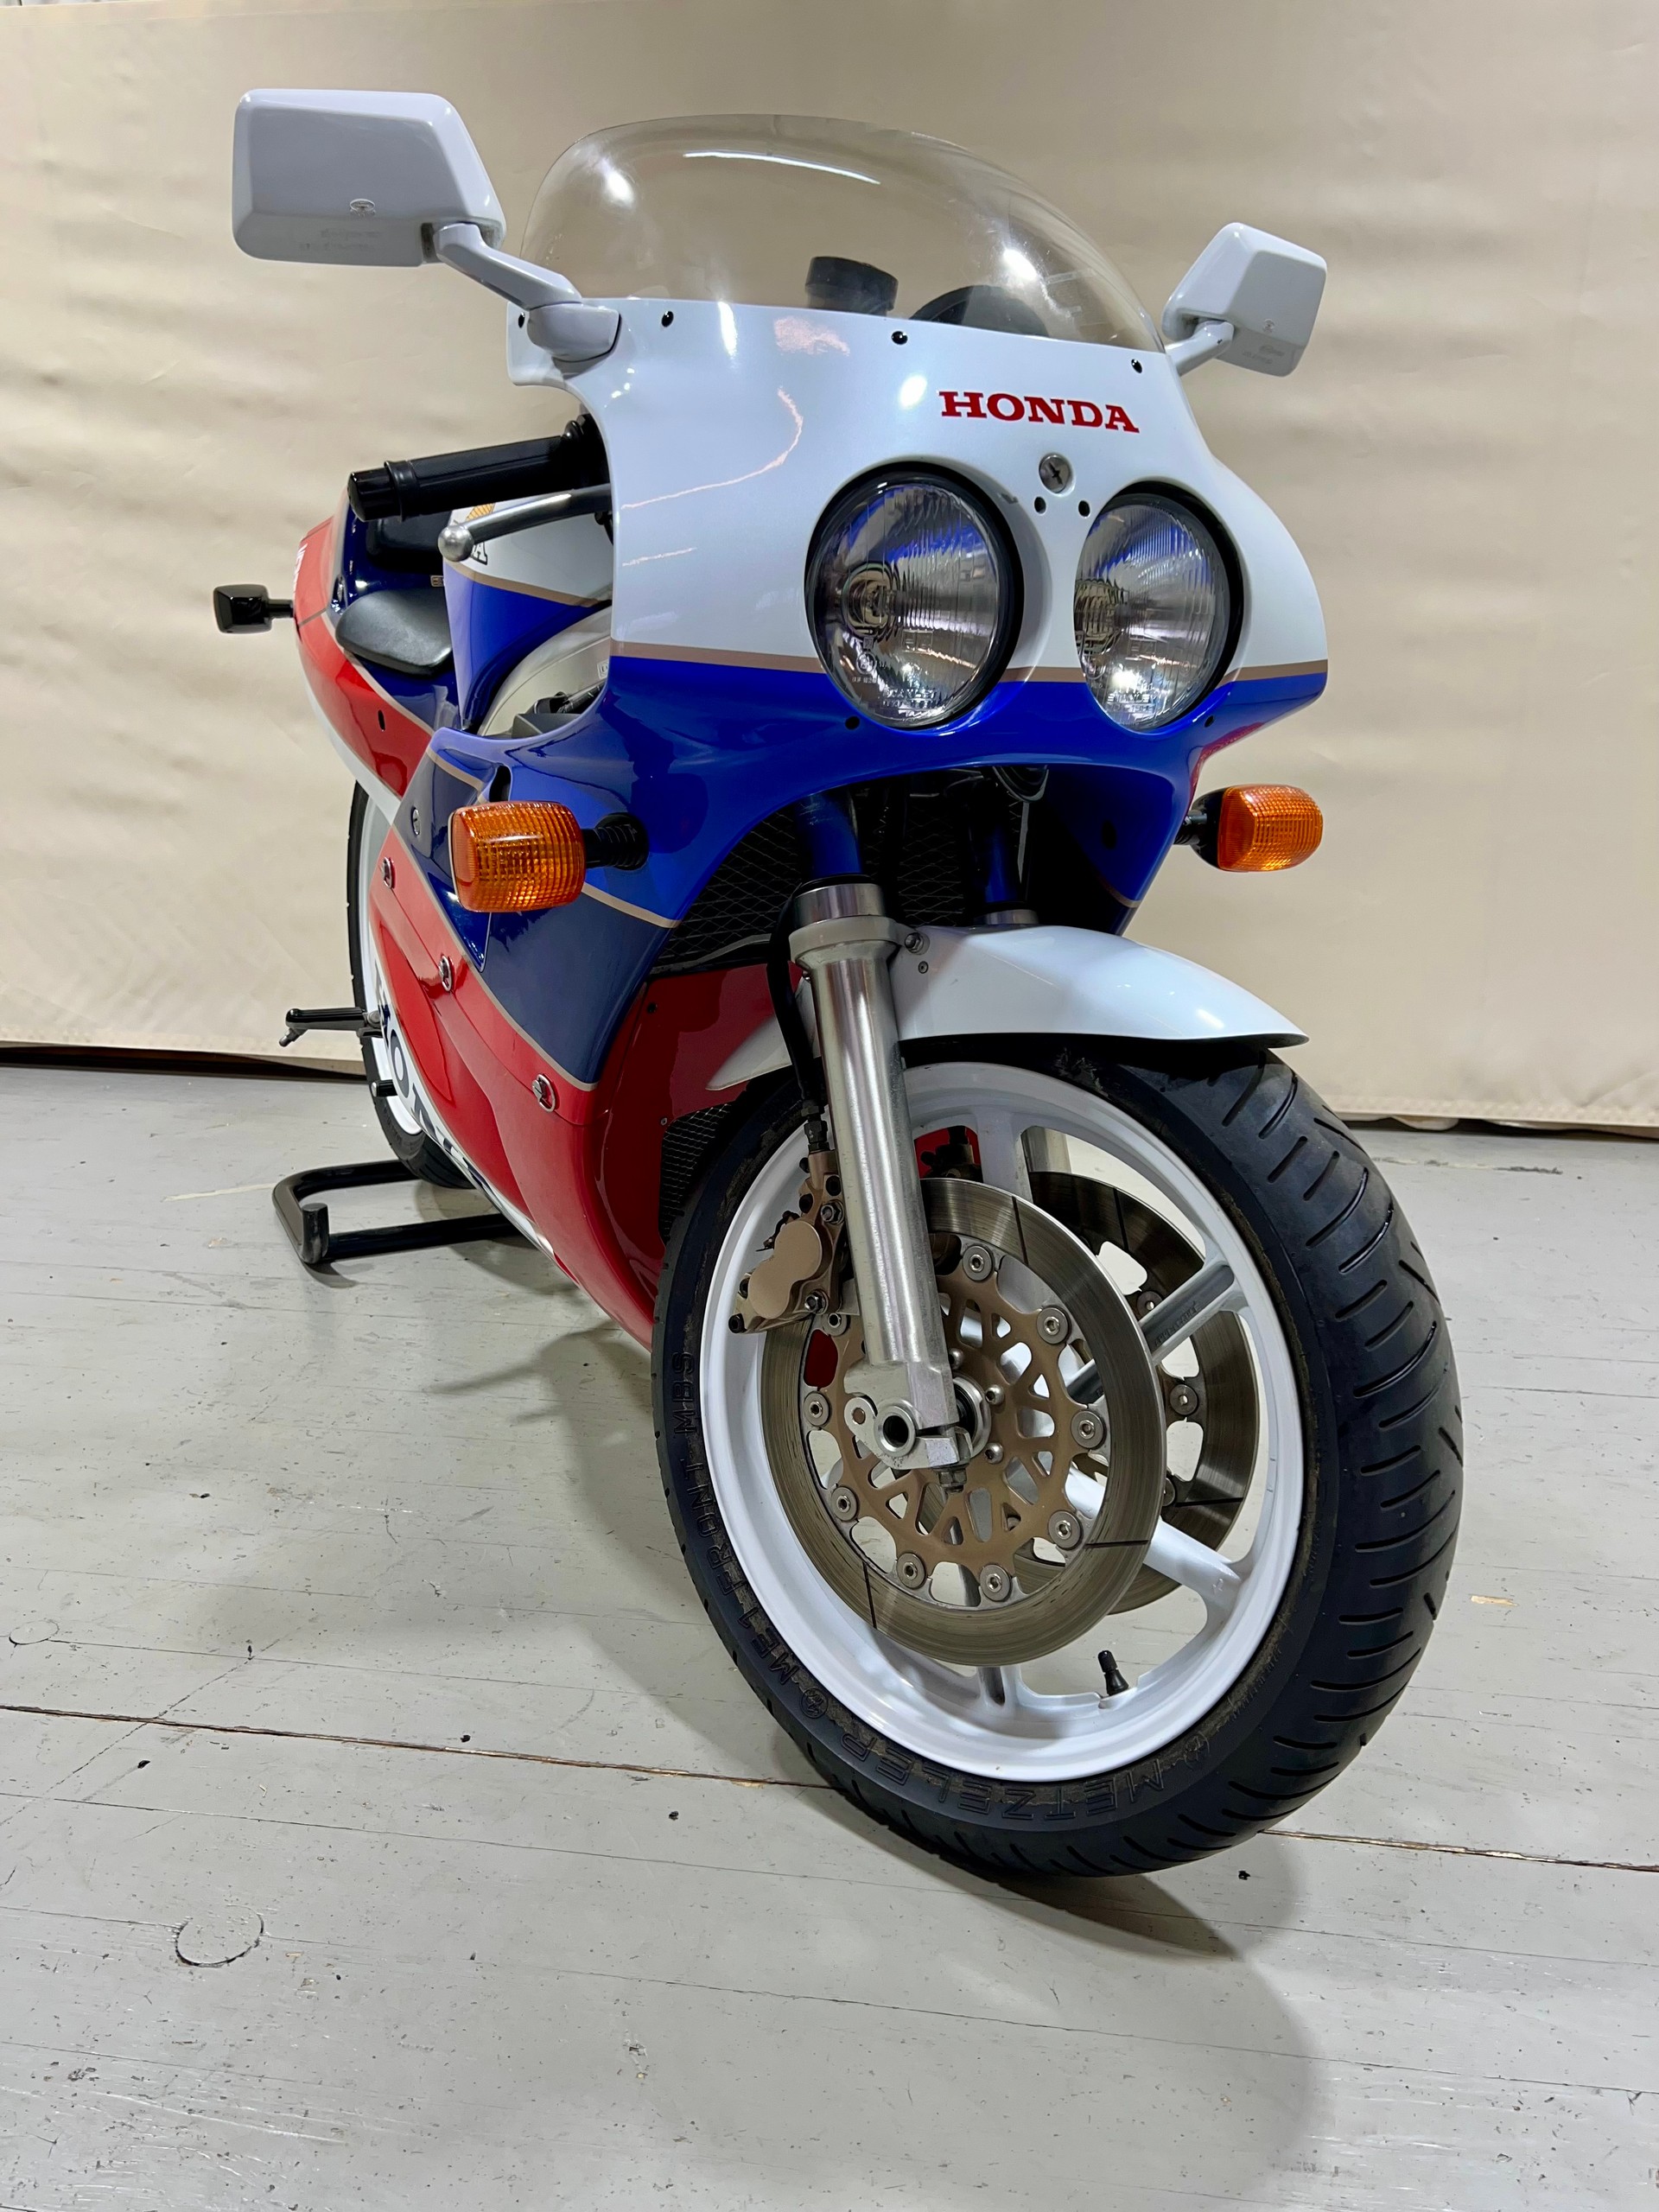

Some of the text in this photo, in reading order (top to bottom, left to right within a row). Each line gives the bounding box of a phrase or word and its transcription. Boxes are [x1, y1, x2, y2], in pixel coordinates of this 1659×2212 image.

[938, 391, 1140, 434] HONDA
[671, 1351, 800, 1685] ME1 FRONT MBS
[840, 1732, 1165, 1821] METZELER
